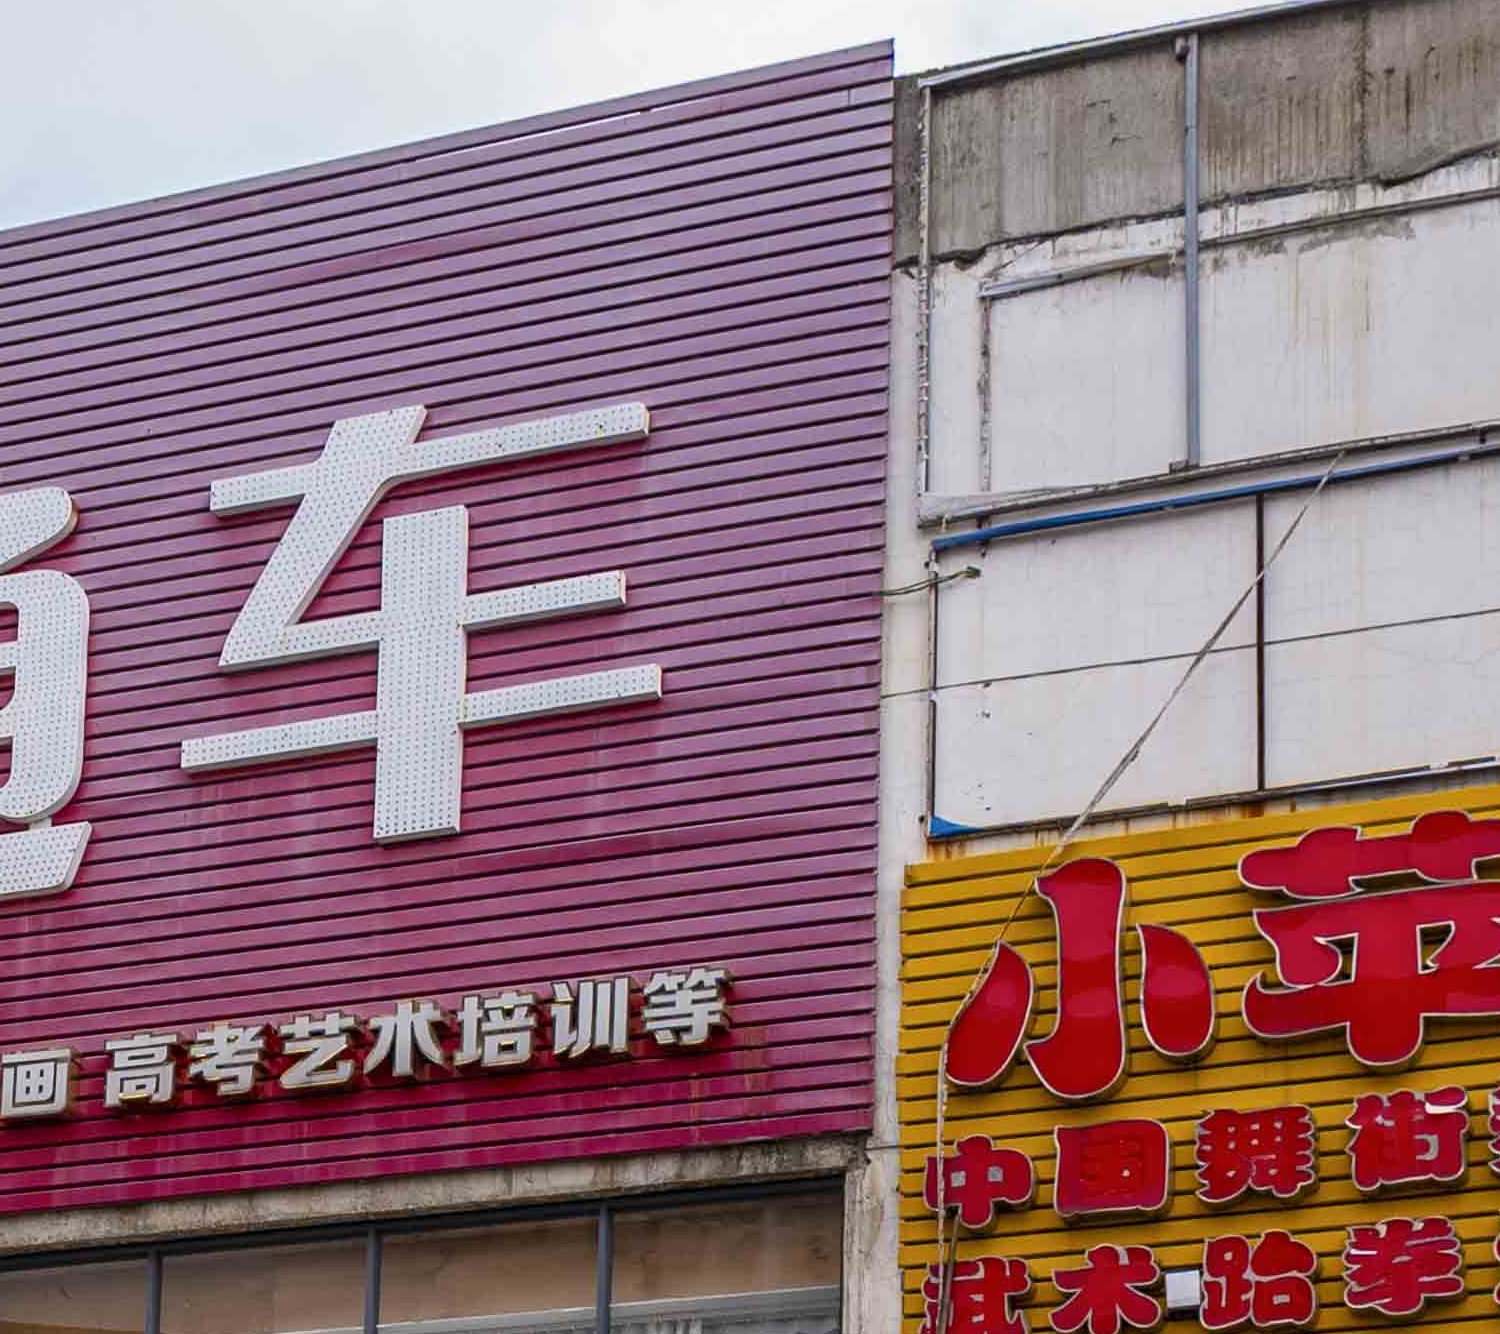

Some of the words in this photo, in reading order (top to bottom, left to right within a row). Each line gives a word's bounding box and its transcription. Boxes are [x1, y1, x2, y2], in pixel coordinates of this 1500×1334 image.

[103, 966, 730, 1108] 高考艺术培训等
